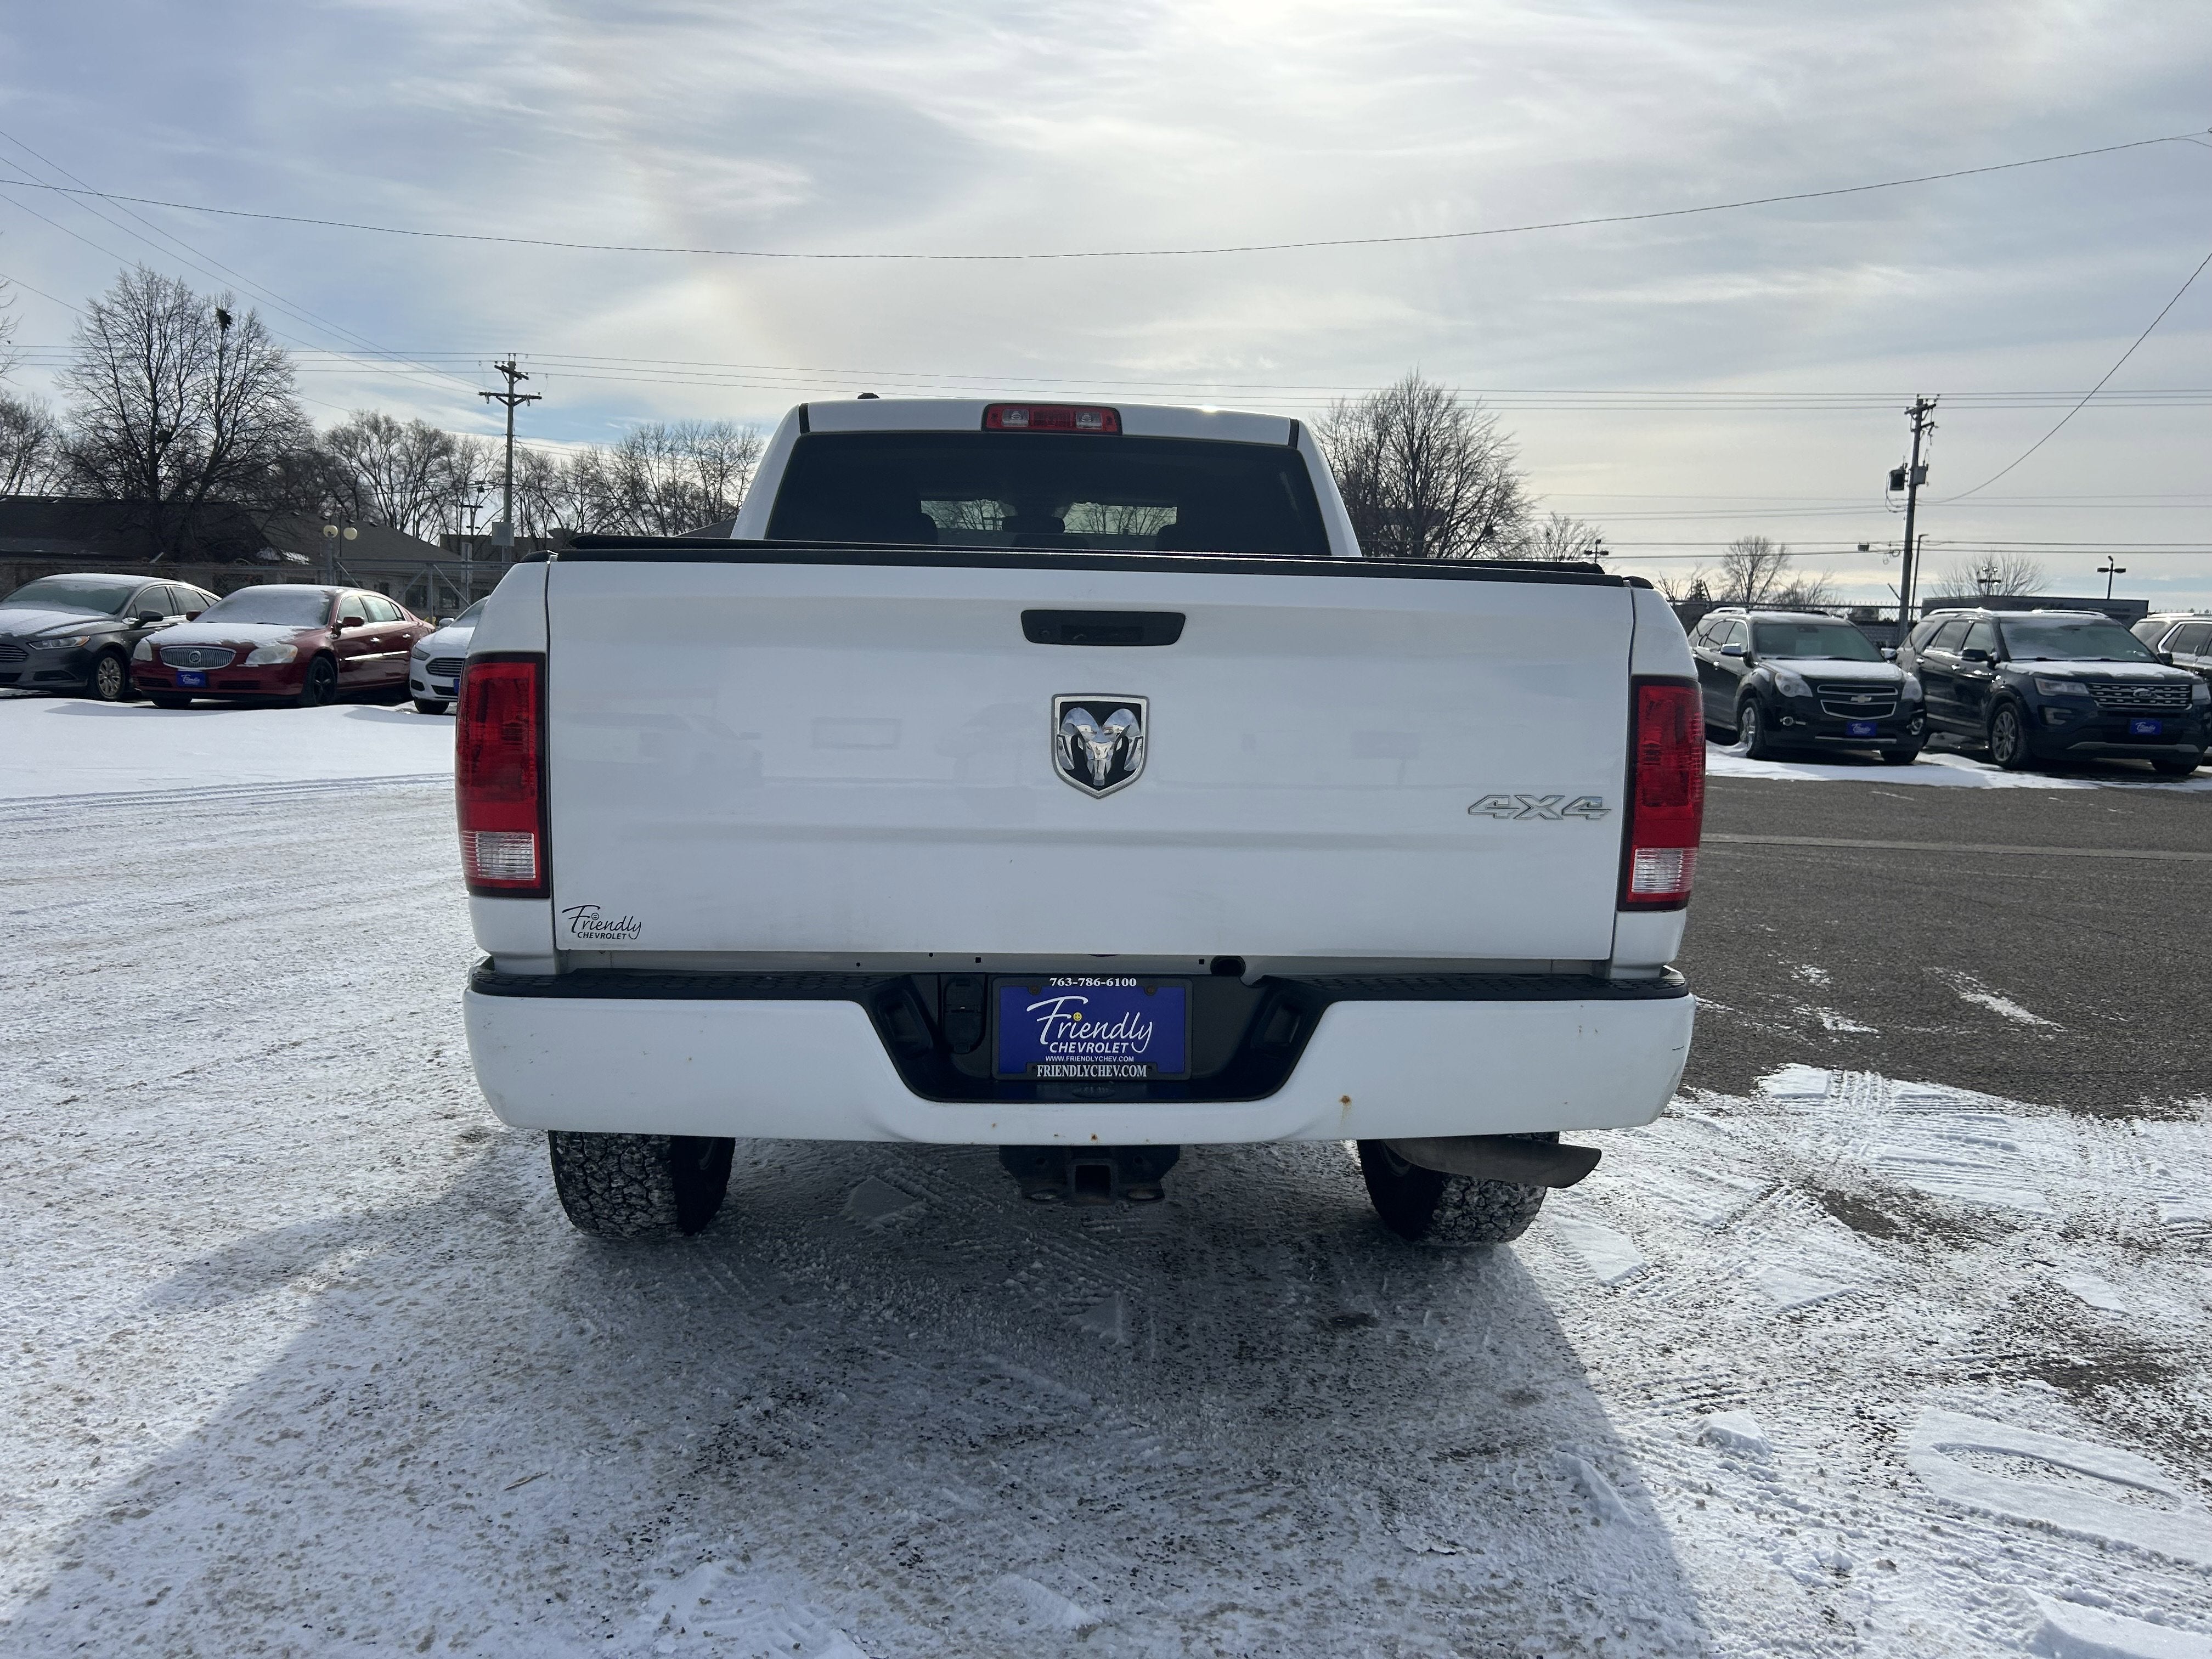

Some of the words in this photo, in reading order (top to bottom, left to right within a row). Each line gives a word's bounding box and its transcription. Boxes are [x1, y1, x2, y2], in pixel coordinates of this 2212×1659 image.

[1468, 794, 1612, 820] 4X4
[562, 905, 642, 940] Friendly
[577, 932, 627, 940] CHEVROLET
[1049, 978, 1137, 987] 763-786-6100
[1026, 995, 1153, 1053] Friendly
[1049, 1041, 1129, 1053] CHEVROLET
[1036, 1064, 1147, 1078] FRIENDLYCHEV.COM
